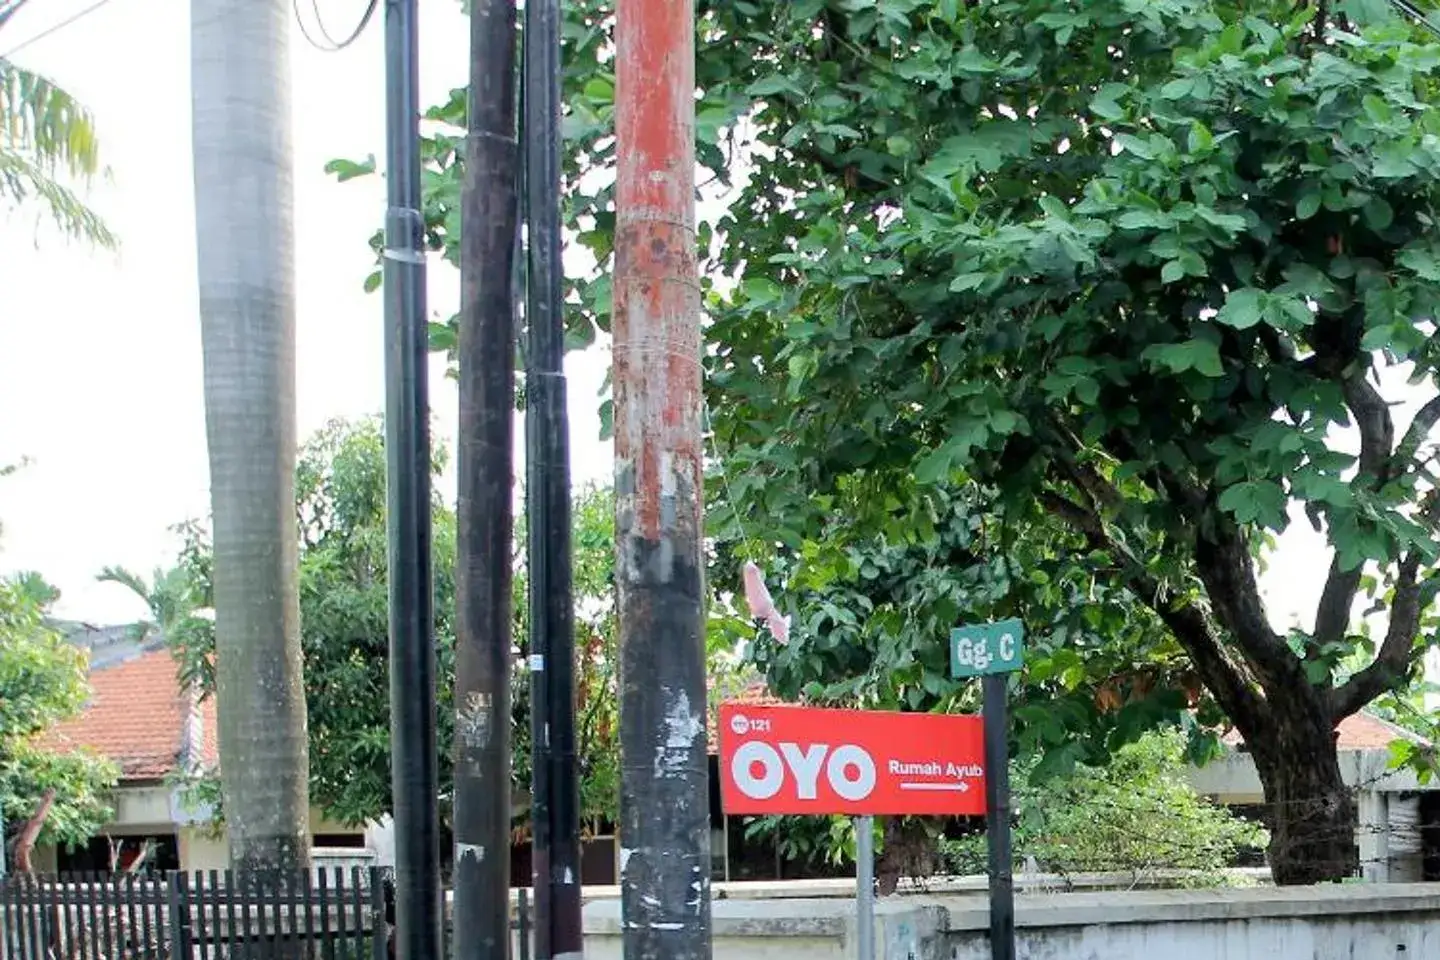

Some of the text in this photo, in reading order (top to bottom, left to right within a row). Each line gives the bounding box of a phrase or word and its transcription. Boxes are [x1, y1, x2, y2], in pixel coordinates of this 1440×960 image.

[957, 633, 1015, 670] Gg. C
[750, 718, 771, 732] 121
[731, 741, 877, 801] OYO
[888, 759, 984, 779] Rumah Ayub
